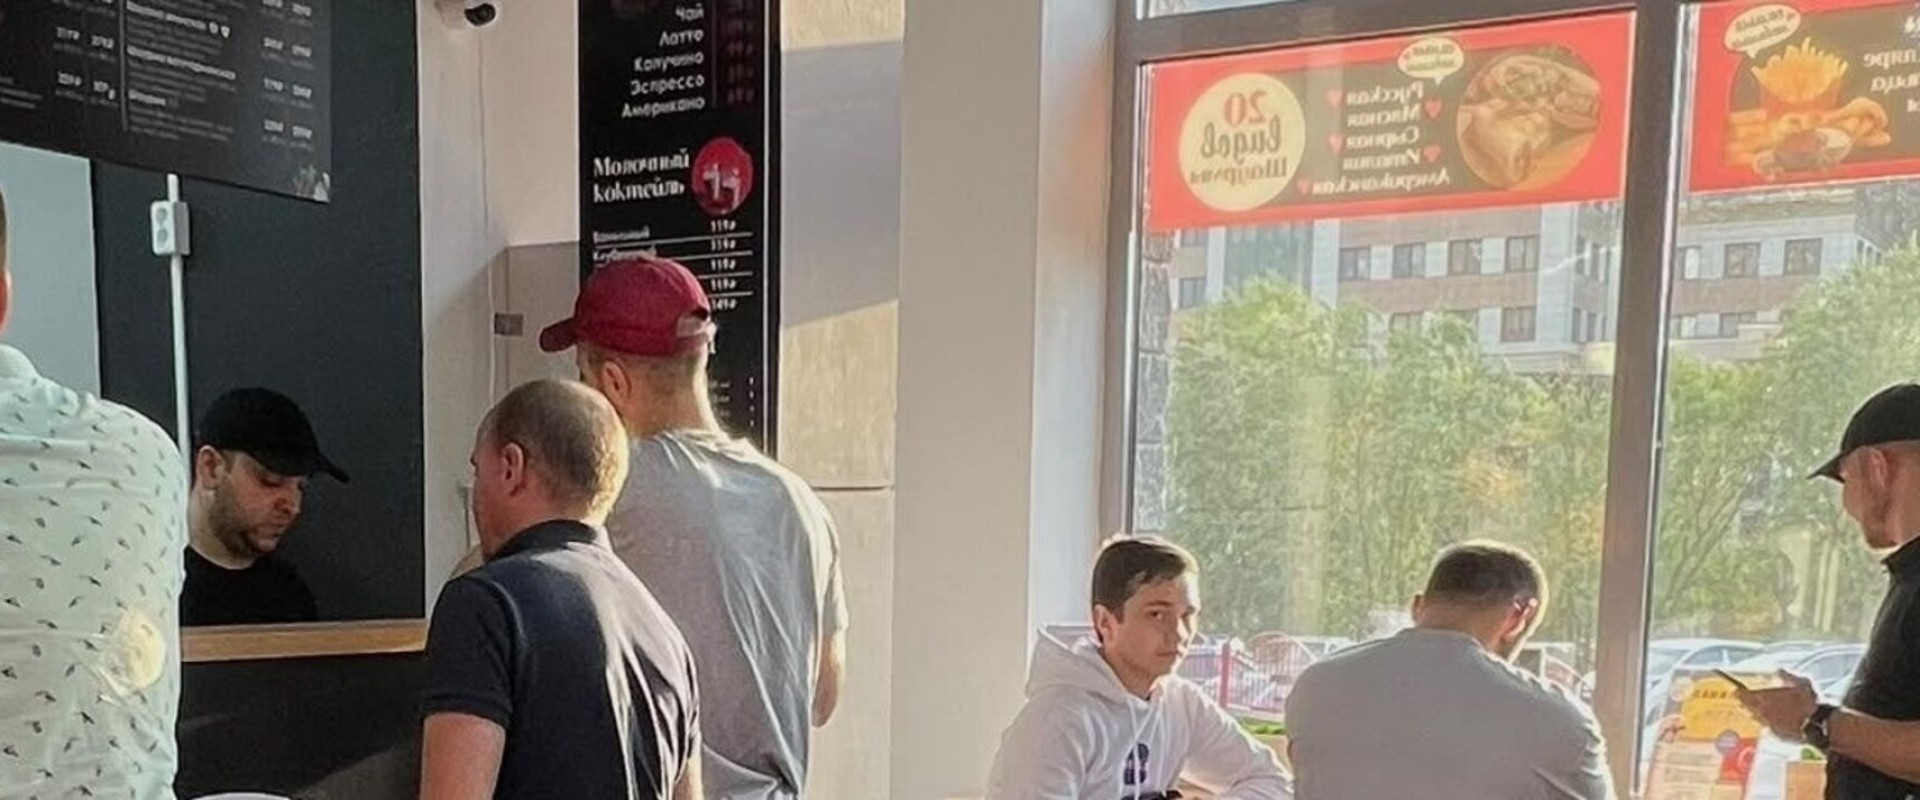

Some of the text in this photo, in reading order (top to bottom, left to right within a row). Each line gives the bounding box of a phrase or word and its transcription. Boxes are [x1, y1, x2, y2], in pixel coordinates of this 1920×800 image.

[675, 2, 704, 21] Чай
[634, 52, 704, 72] Капучино
[630, 75, 705, 96] Эспрессо
[621, 97, 705, 118] Американо
[593, 148, 690, 177] Молочный
[593, 177, 686, 203] коктейль
